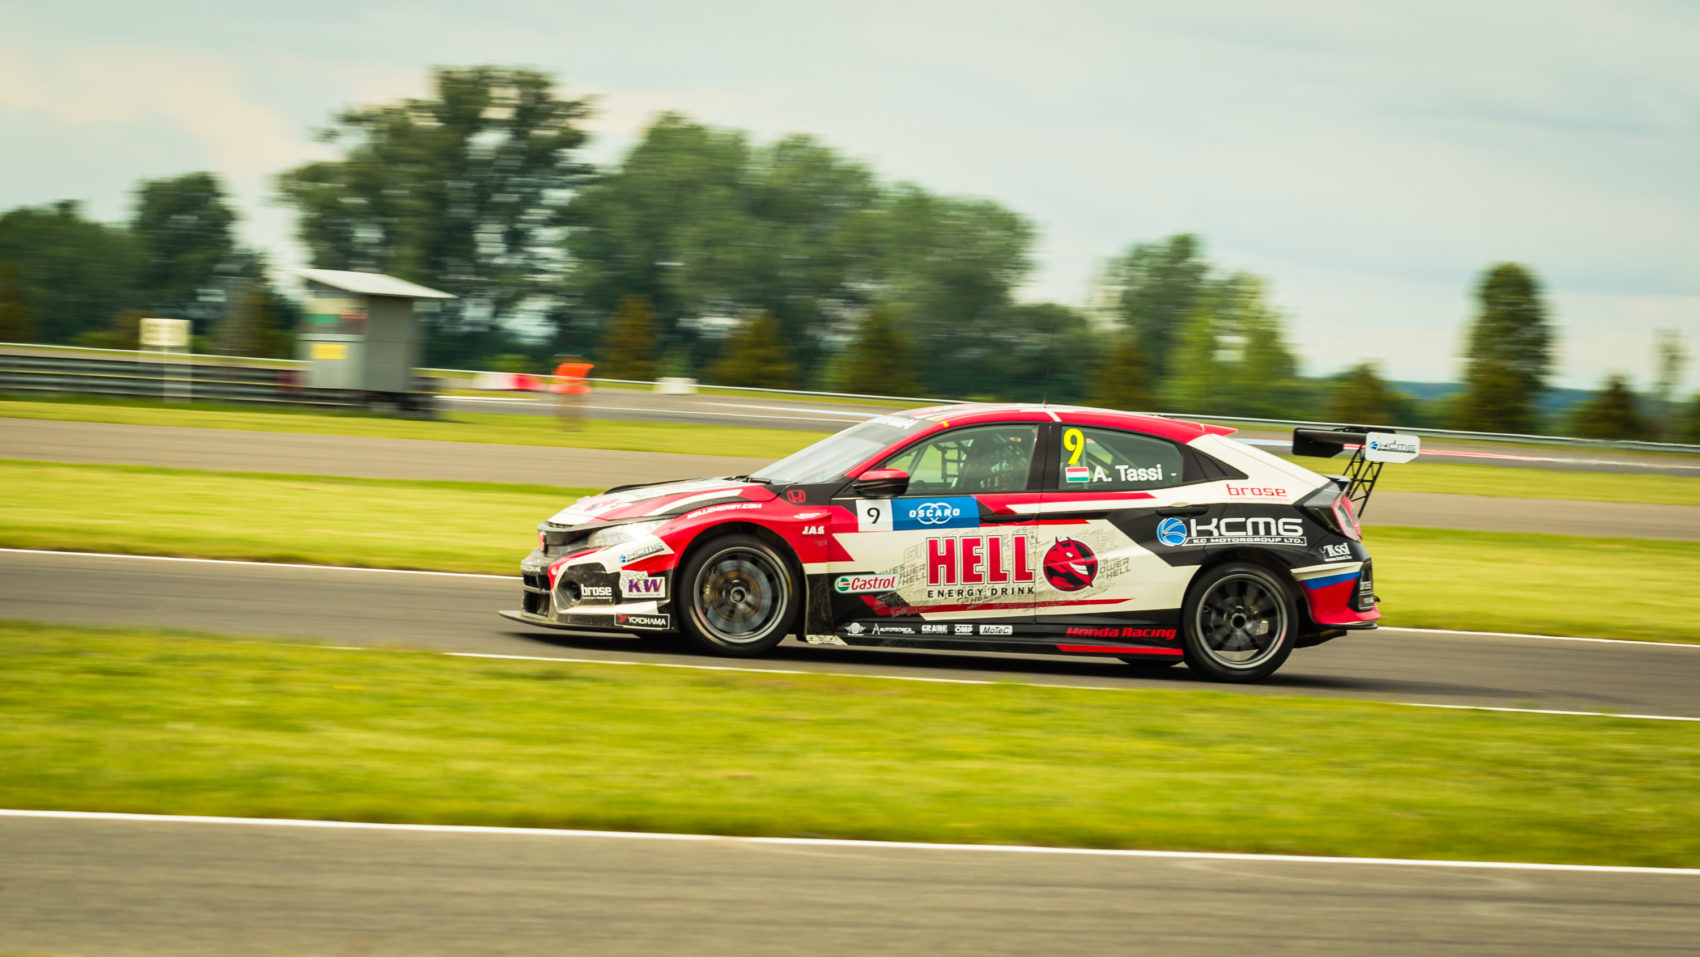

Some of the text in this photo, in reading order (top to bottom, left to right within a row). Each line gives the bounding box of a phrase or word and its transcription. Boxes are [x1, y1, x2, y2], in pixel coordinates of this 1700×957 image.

[1063, 427, 1085, 465] 9
[1092, 464, 1163, 483] A. Tassi
[1225, 483, 1287, 498] brose
[867, 507, 881, 525] 9
[908, 508, 960, 518] OSCARO
[801, 525, 825, 536] JAS
[1190, 517, 1304, 537] KCMG
[926, 533, 1035, 586] HELL
[581, 584, 612, 596] brose
[628, 578, 664, 593] KW
[851, 576, 896, 591] Castrol
[927, 587, 983, 599] ENERGY
[991, 586, 1034, 596] DRINK
[627, 615, 667, 626] YOKOHAMA
[1065, 627, 1176, 640] Honda Racing
